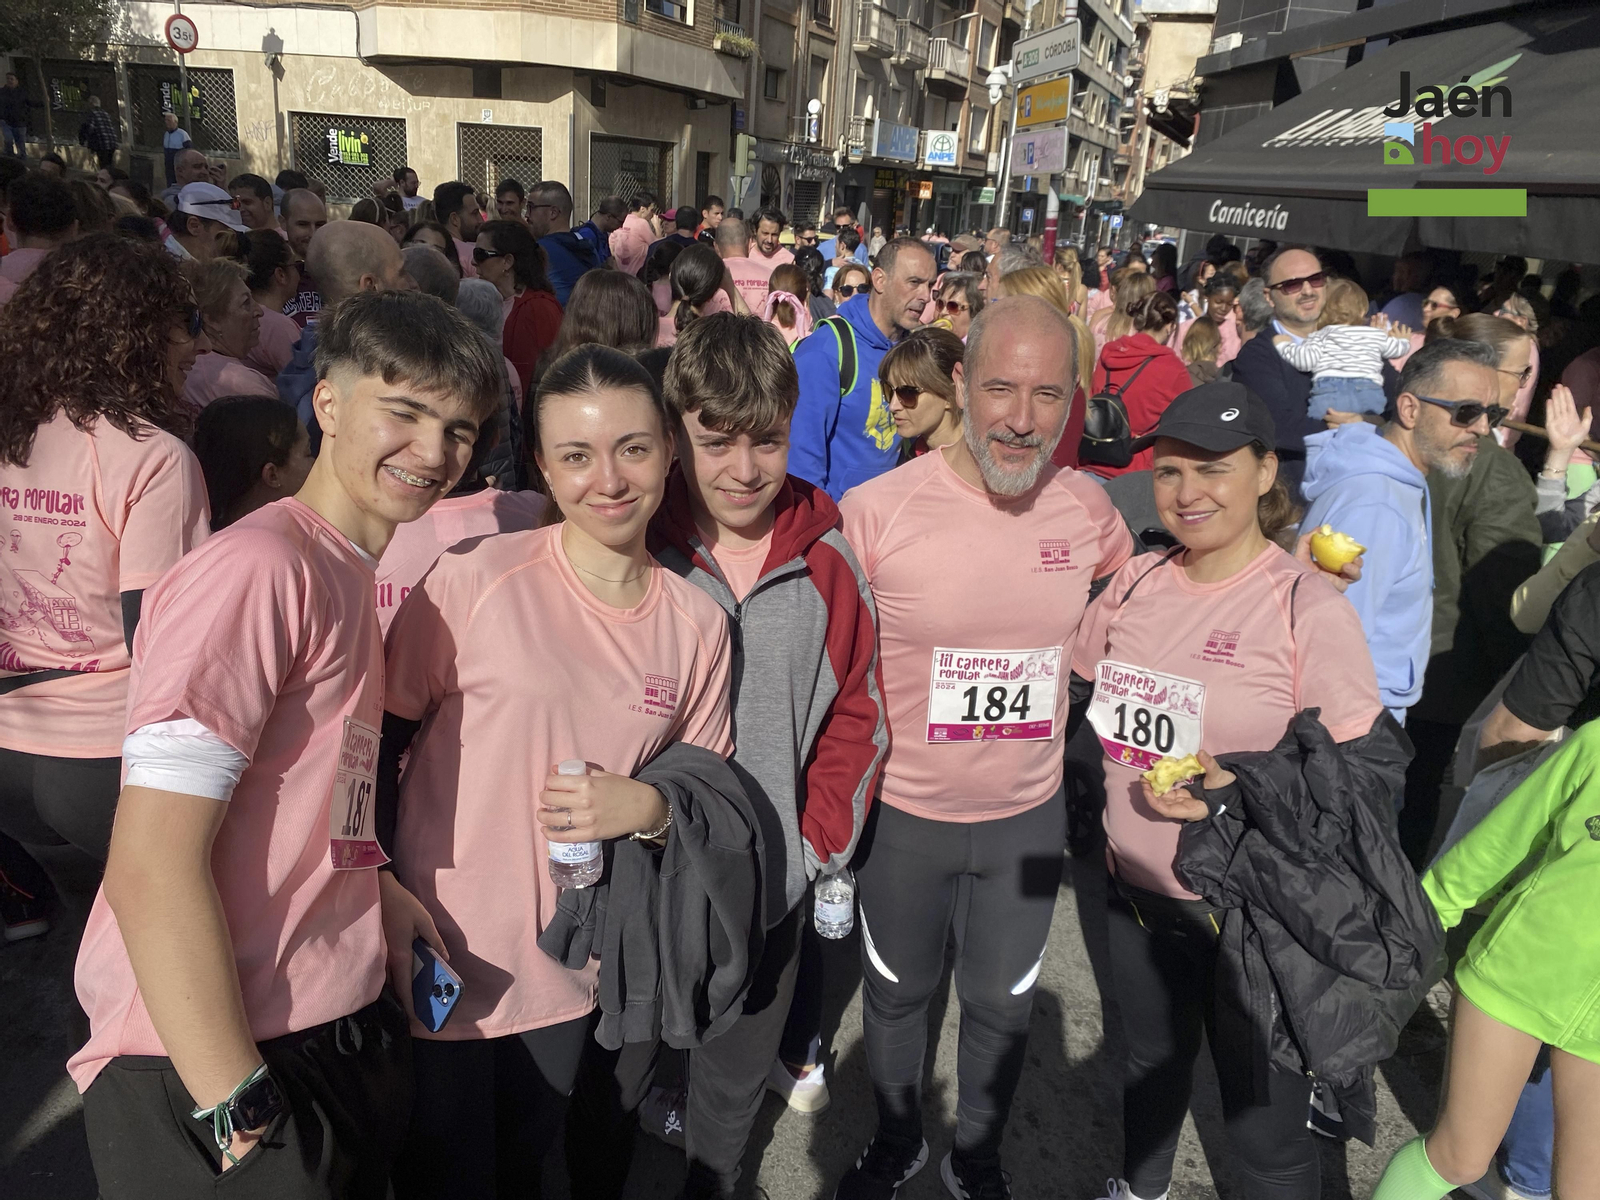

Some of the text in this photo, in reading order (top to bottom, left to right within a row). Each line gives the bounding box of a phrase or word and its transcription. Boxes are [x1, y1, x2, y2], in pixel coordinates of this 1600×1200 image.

[1045, 39, 1076, 60] CÓRDOBA
[326, 128, 339, 163] Vende
[338, 130, 362, 153] livin
[893, 124, 918, 153] ANPE
[928, 152, 955, 161] ANPE
[1209, 199, 1289, 230] Carnicería
[13, 514, 23, 522] 28
[34, 516, 59, 526] ENERO
[60, 519, 87, 528] 2024
[1225, 659, 1245, 669] Bosco
[644, 708, 657, 716] San
[961, 684, 1031, 722] 184
[1113, 703, 1175, 753] 180
